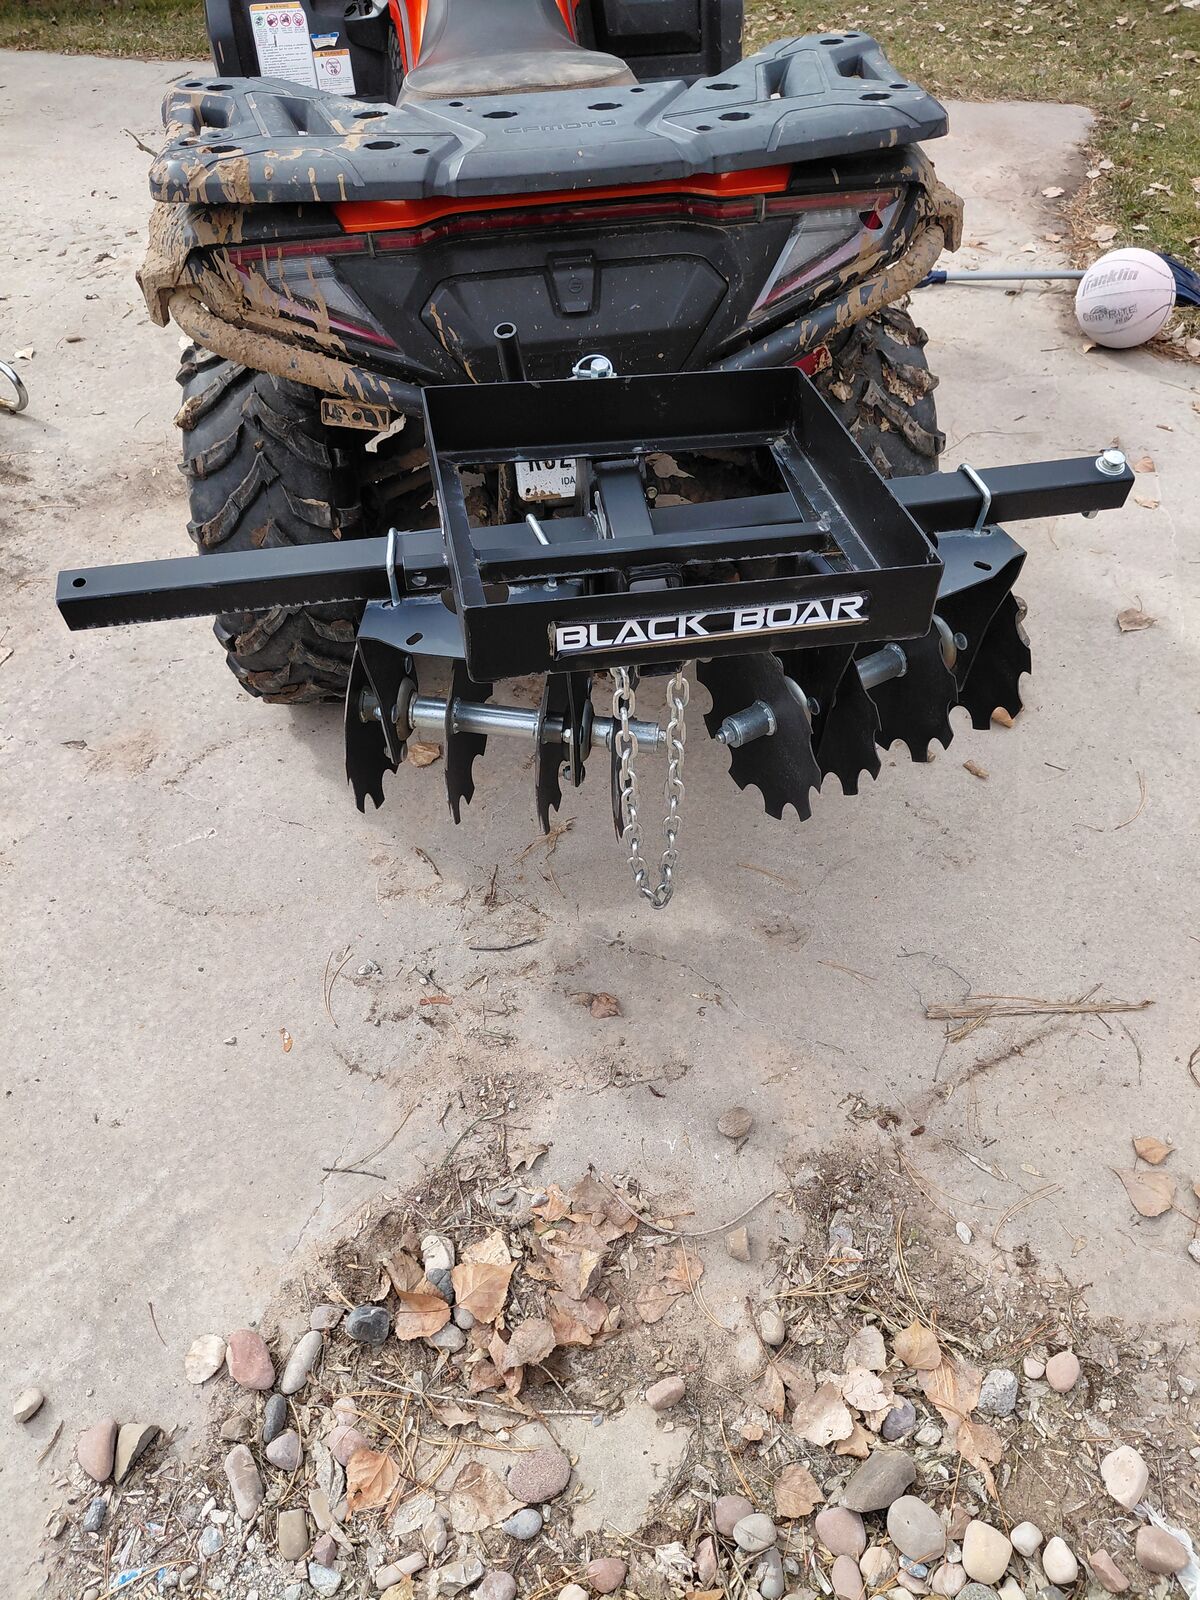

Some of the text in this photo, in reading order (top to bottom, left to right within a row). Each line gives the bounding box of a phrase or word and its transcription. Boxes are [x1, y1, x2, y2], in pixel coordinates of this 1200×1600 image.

[503, 119, 617, 134] CFMOTO
[556, 595, 864, 651] BLACK BOAR
